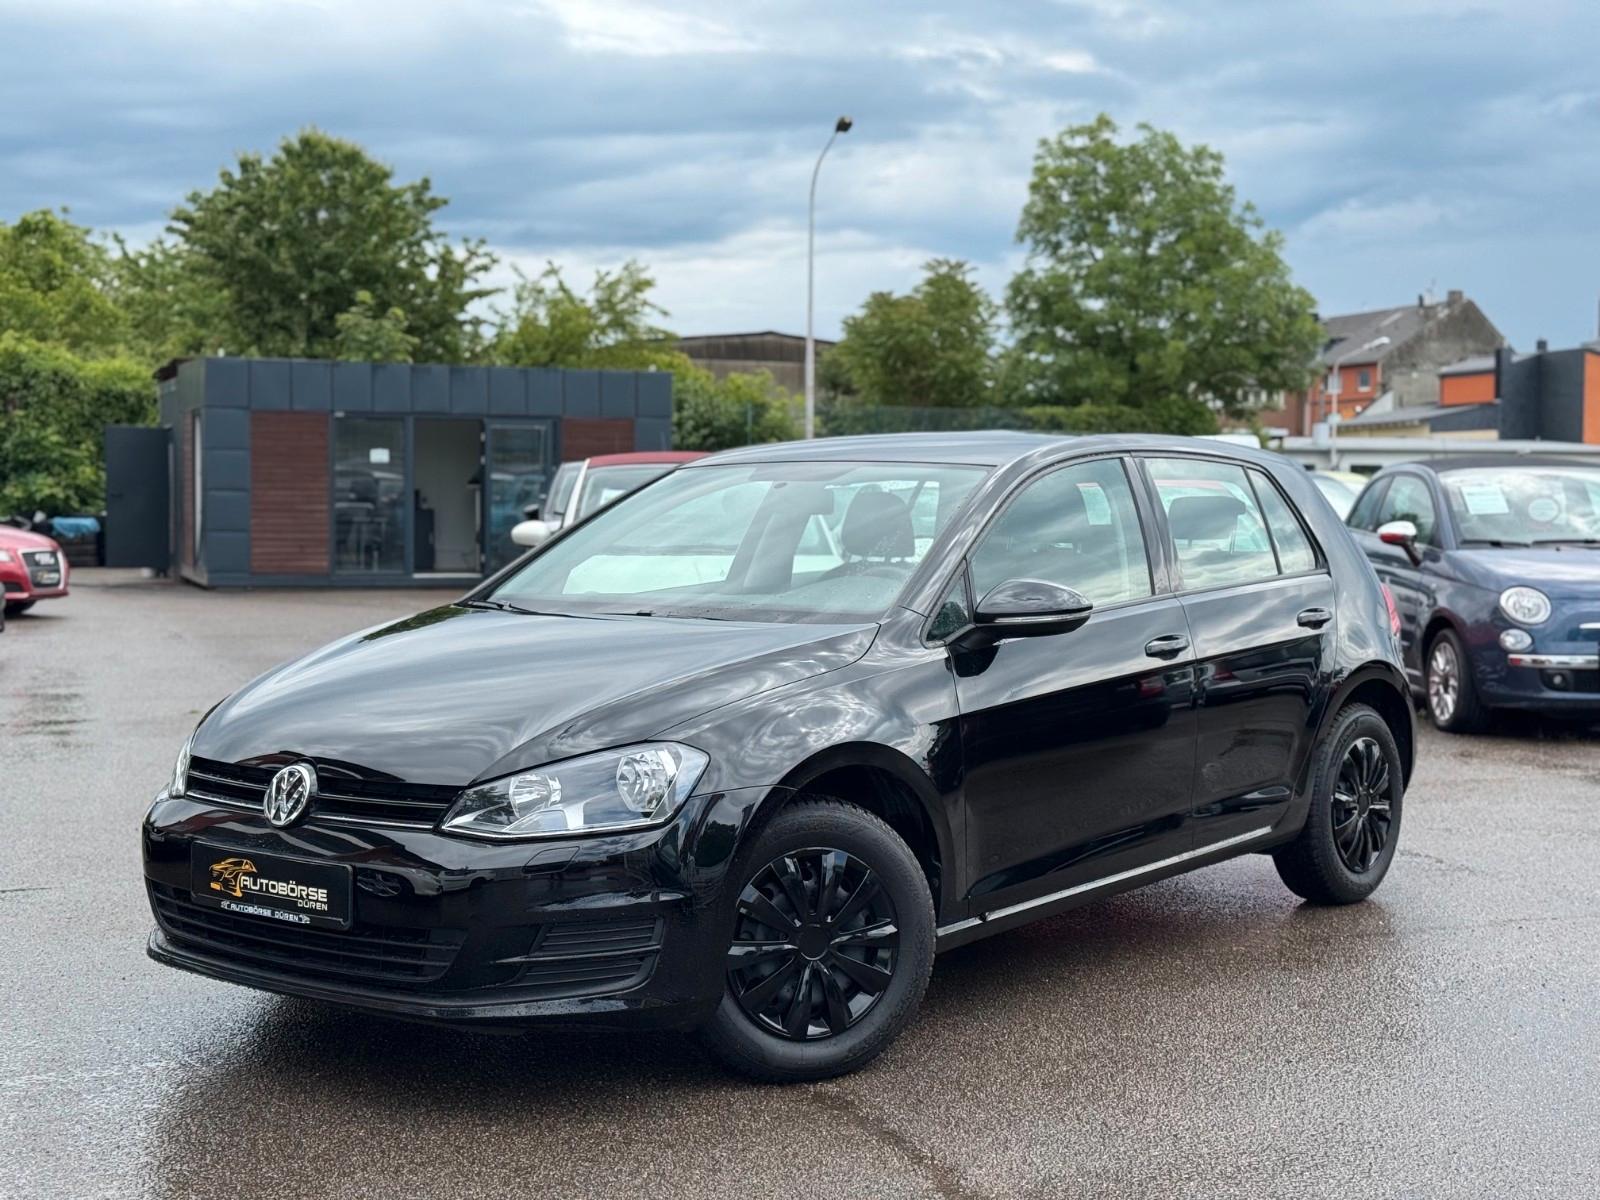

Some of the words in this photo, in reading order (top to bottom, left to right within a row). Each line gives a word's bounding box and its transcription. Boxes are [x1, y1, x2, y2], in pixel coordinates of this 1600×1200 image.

[241, 876, 328, 901] AUTOBÖRSE
[230, 903, 272, 917] AUTOBÖRSE
[275, 909, 299, 922] DÜREN
[297, 899, 328, 911] DÜREN
